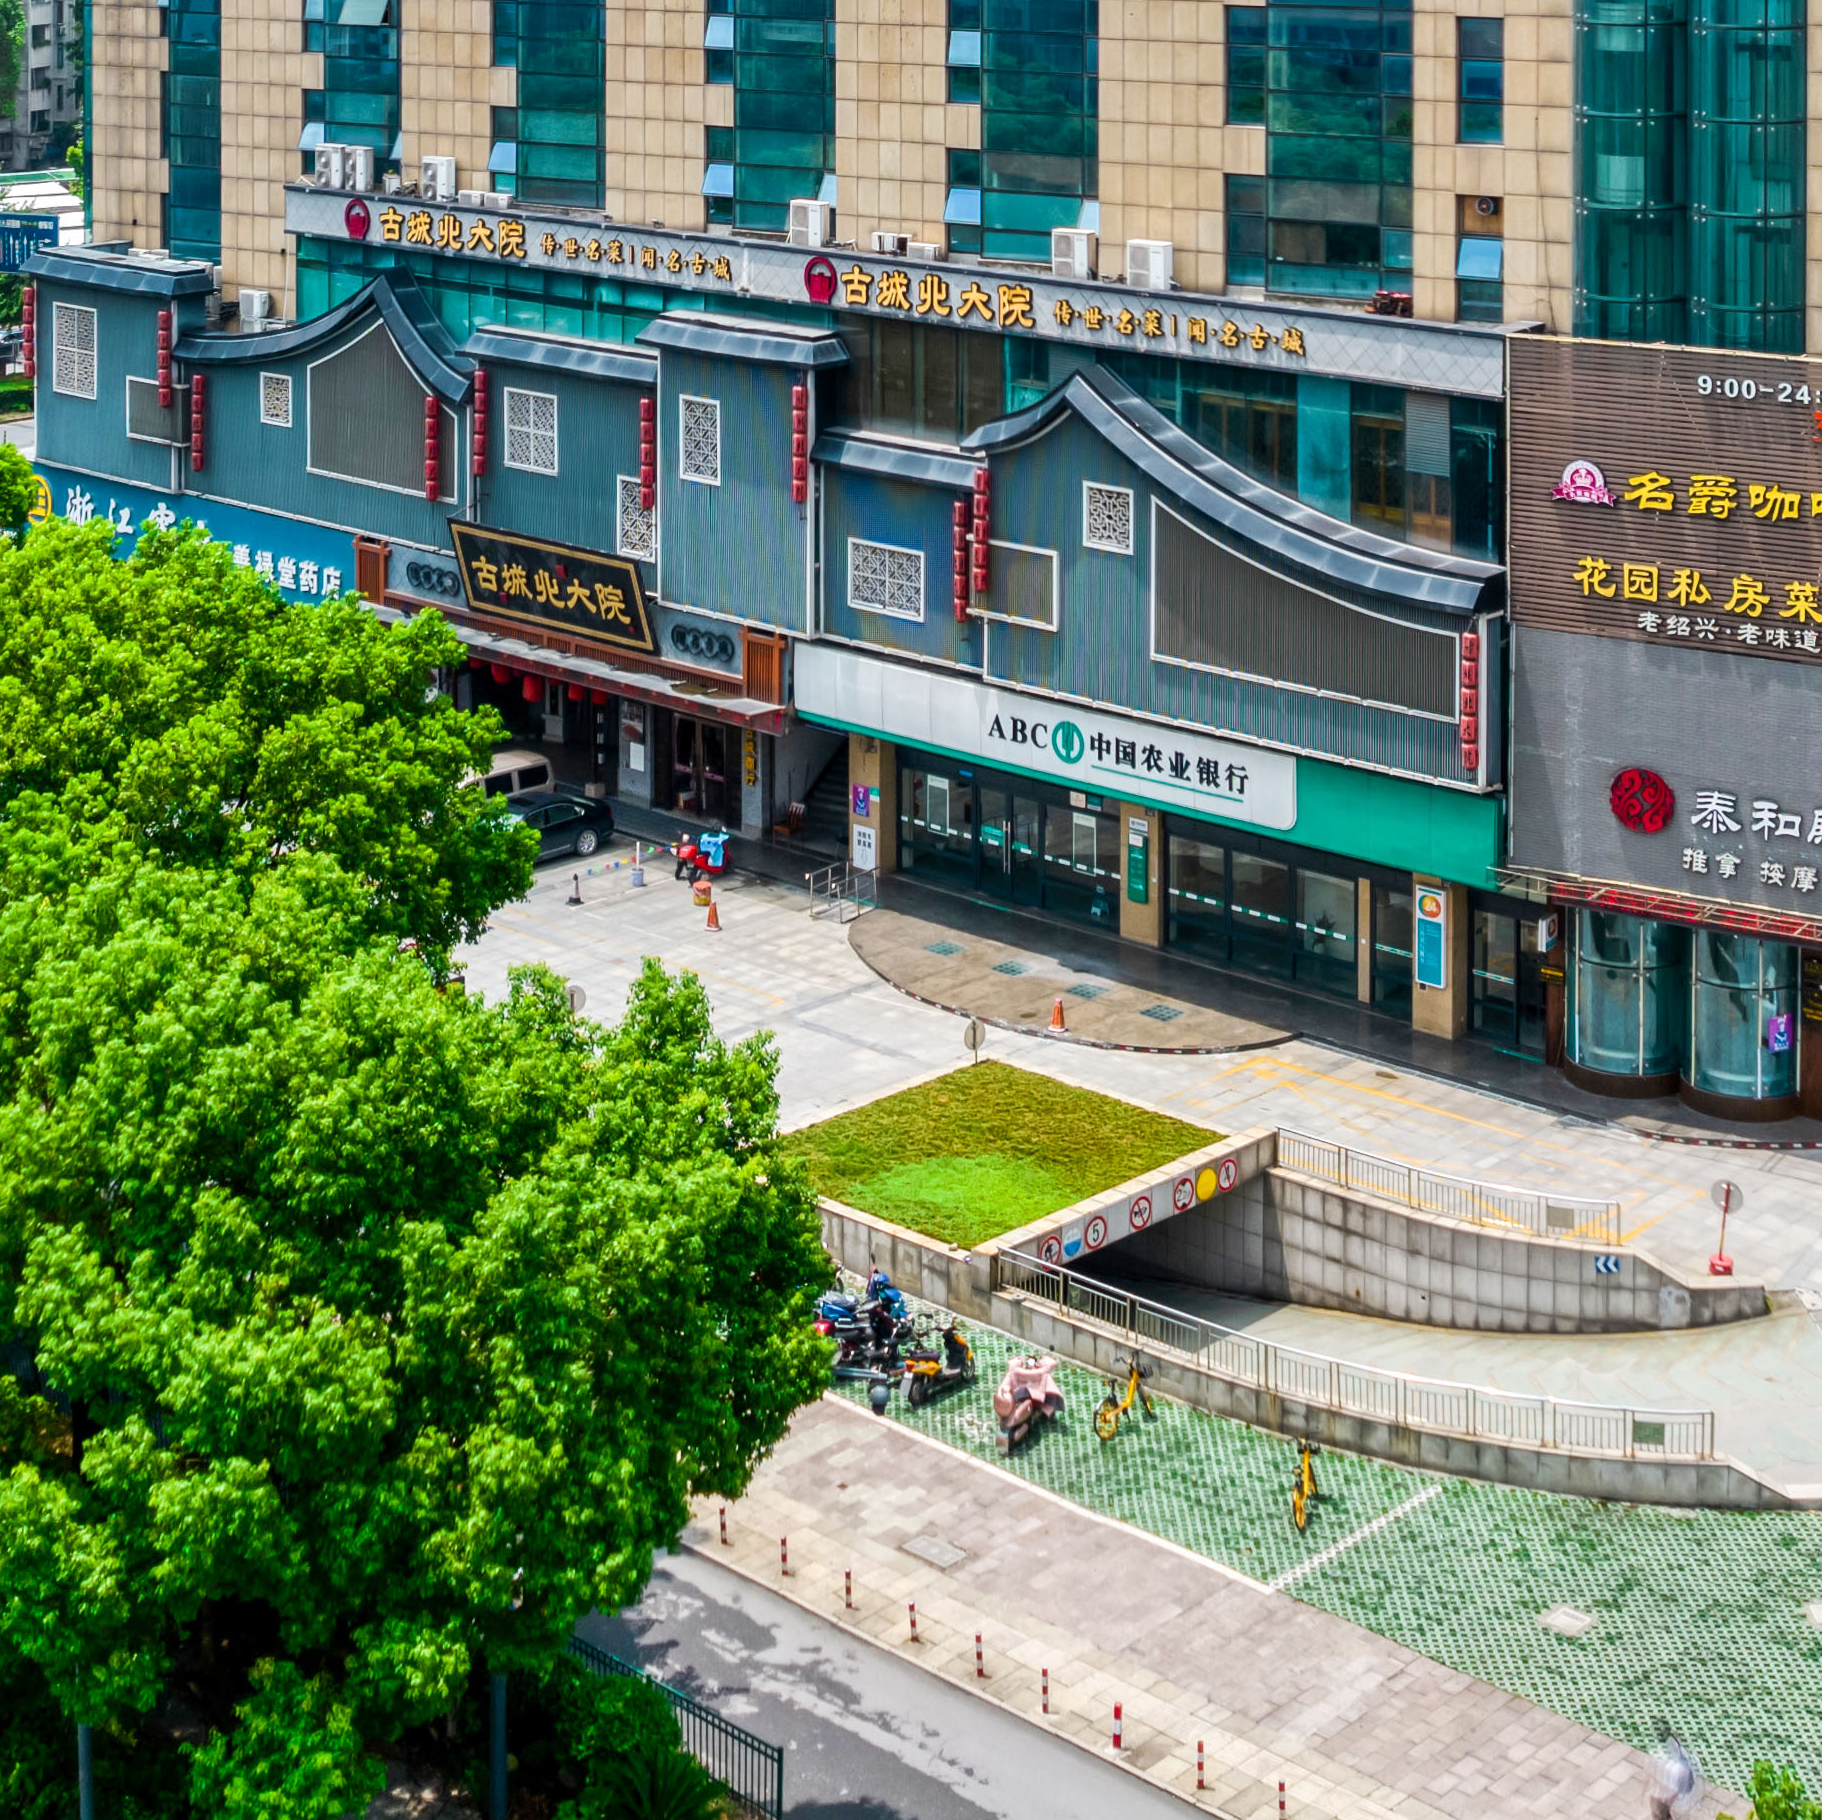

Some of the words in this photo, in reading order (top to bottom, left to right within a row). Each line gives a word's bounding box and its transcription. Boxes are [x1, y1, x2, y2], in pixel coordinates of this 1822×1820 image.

[379, 205, 526, 259] 古城北大院
[840, 264, 1034, 328] 古城北大院
[472, 555, 632, 625] 古城北大院
[988, 714, 1048, 749] ABC
[1090, 731, 1249, 795] 中国农业银行
[1682, 847, 1742, 879] 推拿
[1759, 860, 1819, 893] 按摩
